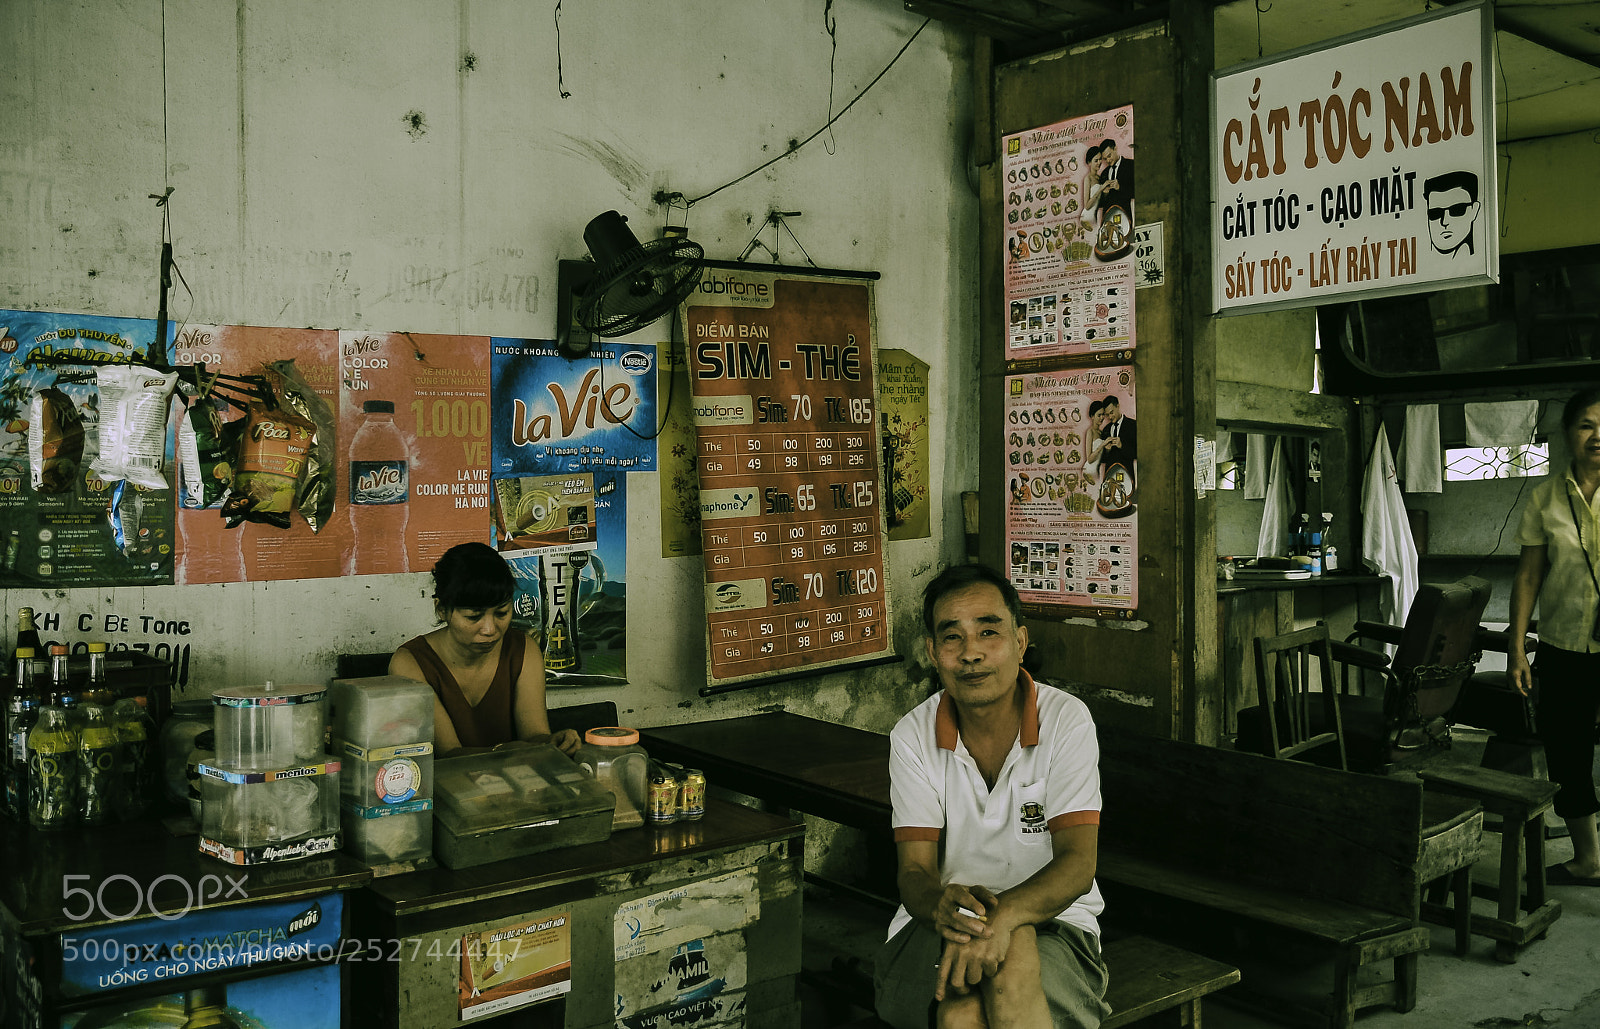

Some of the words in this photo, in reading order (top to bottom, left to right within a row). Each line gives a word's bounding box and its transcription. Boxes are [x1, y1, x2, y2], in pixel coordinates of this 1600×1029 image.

[1223, 77, 1290, 184] CẮT
[1299, 70, 1372, 169] TÓC
[1381, 61, 1475, 153] NAM
[1223, 192, 1258, 240] CẮT
[1263, 189, 1300, 232] TÓC
[1320, 182, 1363, 228] CẠO
[1369, 166, 1417, 219] MẶT
[1225, 251, 1255, 300] SẤY
[1261, 251, 1292, 295] TÓC
[1309, 238, 1341, 288] LẤY
[1346, 237, 1382, 283] RÁY
[1387, 236, 1417, 278] TAI
[58, 328, 77, 338] DU
[175, 329, 212, 350] aVie
[738, 322, 769, 339] BÁN
[495, 346, 520, 355] NƯỚC
[523, 347, 559, 357] KHOÁNG
[696, 341, 772, 380] SIM
[796, 333, 861, 381] THẺ
[343, 358, 389, 369] COLOR
[897, 383, 925, 397] nhàng
[410, 399, 488, 438] 1.000
[791, 394, 812, 421] 70
[849, 398, 872, 424] 185
[254, 421, 289, 439] Poca
[747, 439, 761, 451] 50
[782, 439, 798, 451] 100
[815, 438, 833, 449] 200
[846, 437, 863, 448] 300
[747, 458, 761, 470] 49
[785, 456, 798, 468] 98
[819, 455, 833, 466] 198
[848, 454, 864, 465] 296
[457, 469, 471, 481] LA
[472, 469, 488, 481] VIE
[416, 484, 449, 496] COLOR
[451, 483, 466, 495] ME
[467, 483, 488, 495] RUN
[797, 484, 816, 511] 65
[853, 481, 873, 508] 125
[455, 494, 469, 509] HÀ
[471, 494, 488, 511] NỘI
[753, 531, 767, 543] 50
[789, 526, 805, 539] 100
[820, 524, 837, 536] 200
[852, 522, 868, 534] 300
[791, 547, 804, 559] 98
[823, 543, 837, 555] 196
[853, 541, 868, 552] 296
[803, 572, 824, 600] 70
[856, 567, 878, 595] 120
[760, 623, 774, 635] 50
[795, 617, 810, 629] 100
[825, 612, 842, 624] 200
[857, 606, 873, 619] 300
[760, 642, 774, 653] 49
[798, 636, 810, 648] 98
[830, 630, 845, 643] 198
[275, 767, 318, 780] mentos
[262, 844, 306, 861] Alpenliebe
[202, 926, 287, 953] MATCHA
[99, 967, 149, 988] UỐNG
[154, 961, 189, 979] CHO
[194, 952, 236, 972] NGÀY
[240, 947, 271, 964] THƯ
[668, 1008, 687, 1020] CAO
[688, 1001, 706, 1013] VIỆT
